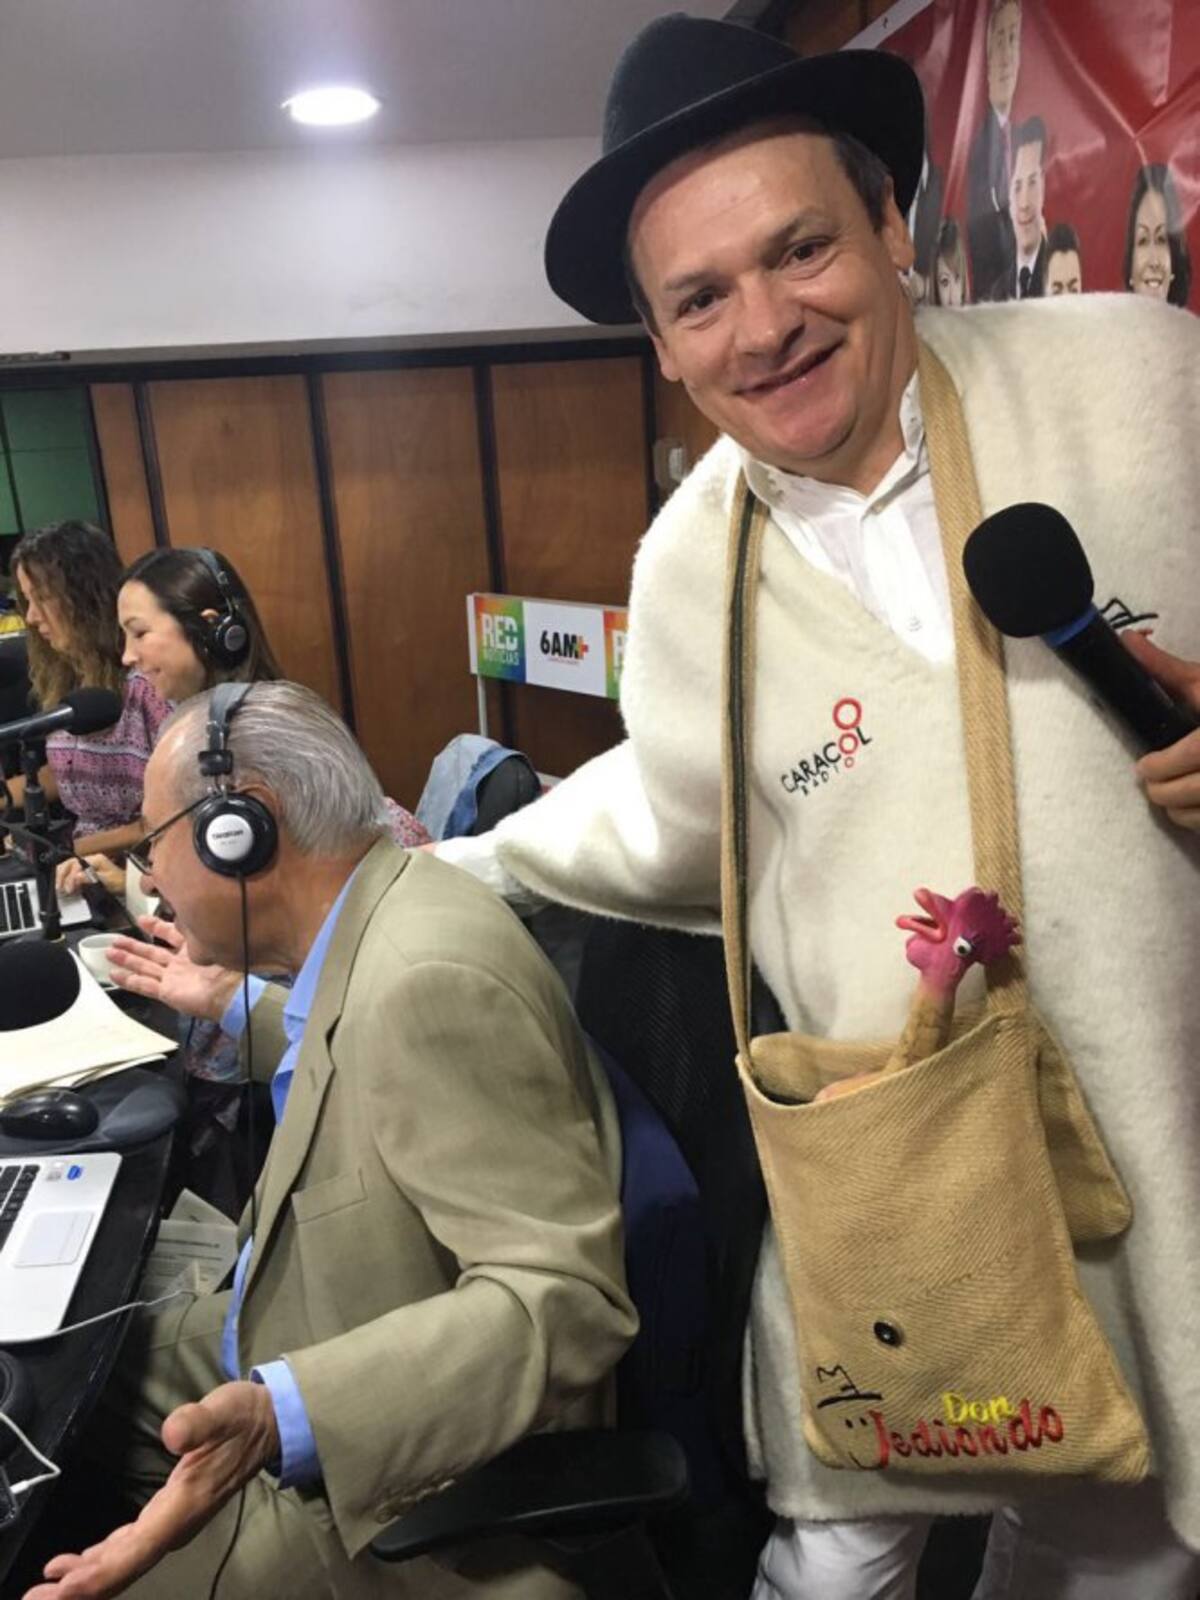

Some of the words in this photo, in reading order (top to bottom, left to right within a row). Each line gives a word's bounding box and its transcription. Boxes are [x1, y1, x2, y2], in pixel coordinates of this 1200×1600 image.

[480, 613, 518, 651] RED
[780, 725, 873, 793] CARACOL
[867, 1398, 1064, 1469] Jediondo
[943, 1392, 1014, 1425] Don
